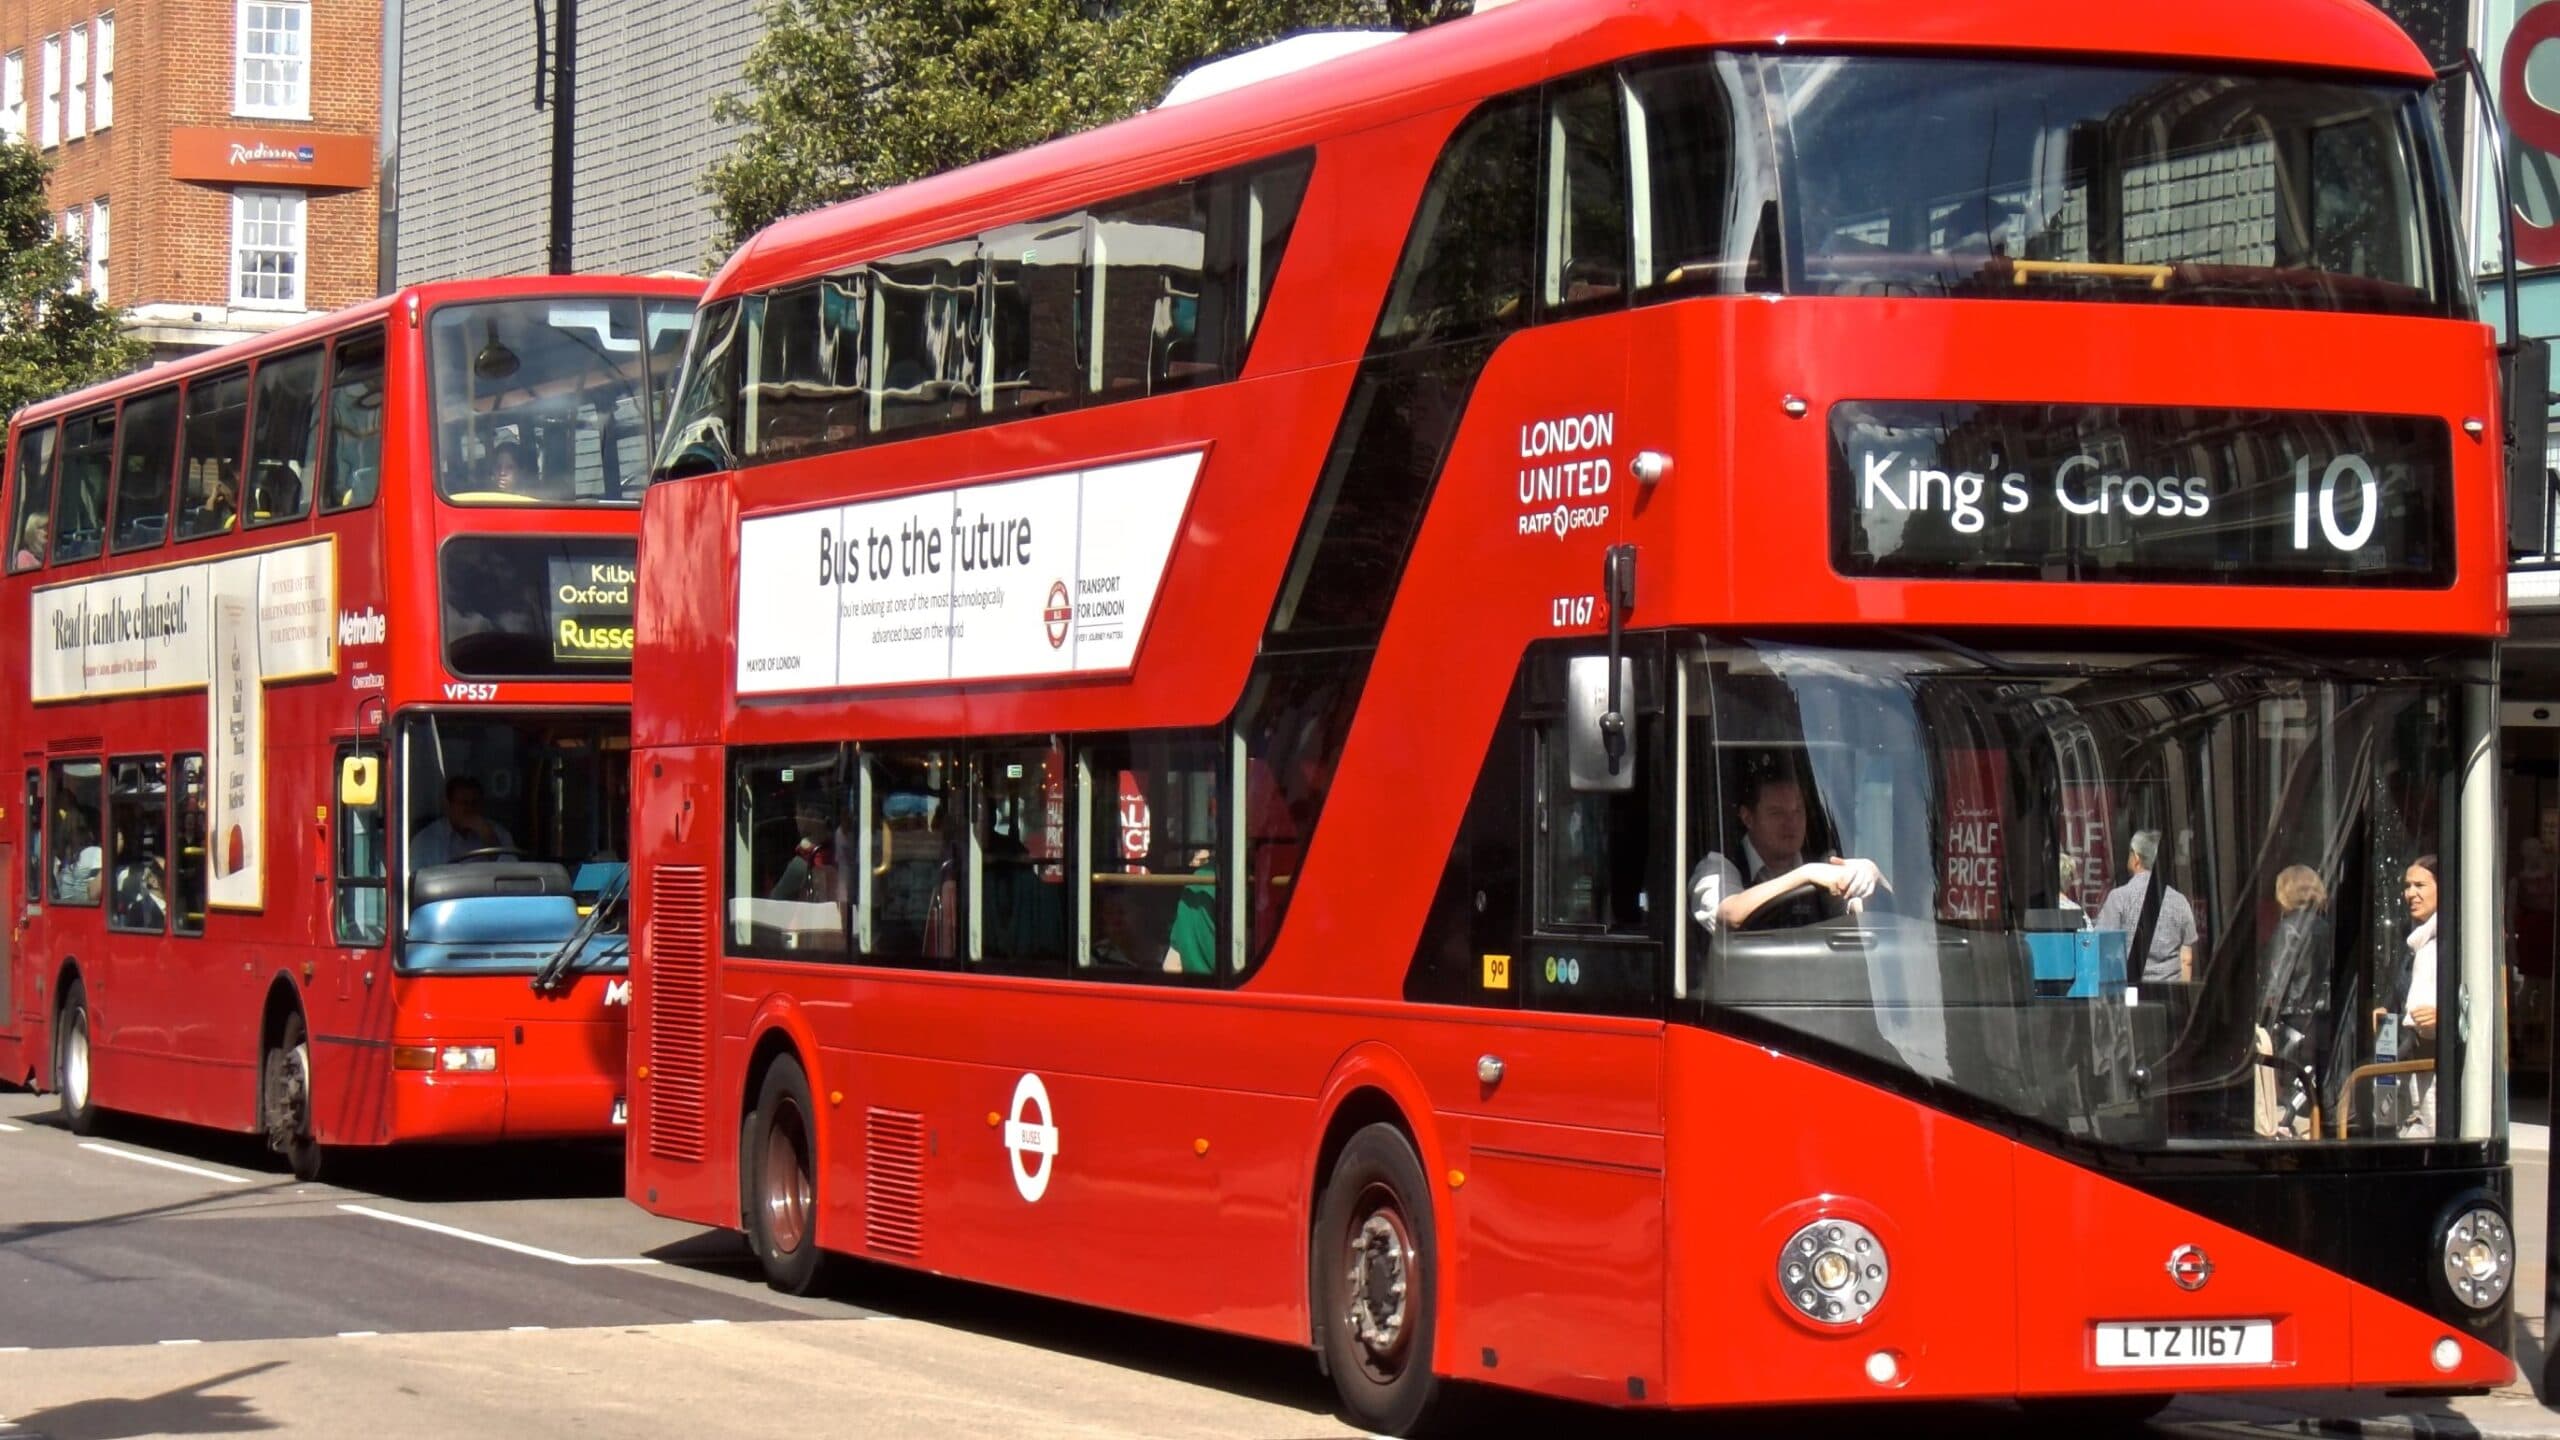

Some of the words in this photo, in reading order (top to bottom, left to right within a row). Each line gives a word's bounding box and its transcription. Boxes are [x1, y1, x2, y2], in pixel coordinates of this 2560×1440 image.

[229, 142, 298, 166] Radisson
[1521, 412, 1614, 458] LONDON
[1519, 459, 1611, 504] UNITED
[1864, 450, 2029, 533] King's
[2055, 455, 2210, 517] Cross
[2294, 454, 2377, 551] 10
[1519, 512, 1552, 535] RATP
[1569, 505, 1609, 530] GROUP
[820, 527, 860, 586] Bus
[868, 527, 893, 581] to
[901, 514, 941, 577] the
[951, 507, 1031, 572] future
[559, 584, 628, 604] Oxford
[1077, 576, 1120, 594] TRANSPORT
[93, 597, 116, 645] and
[118, 596, 132, 642] be
[1077, 603, 1091, 618] FOR
[1092, 600, 1124, 618] LONDON
[1553, 597, 1594, 626] LT167
[338, 606, 385, 646] Metroline
[767, 657, 775, 671] OF
[443, 684, 498, 700] VP557
[1949, 821, 1999, 853] HALF
[1948, 857, 1997, 886] PRICE
[1022, 1129, 1041, 1145] BUSES
[2123, 1326, 2181, 1357] LTZ
[2192, 1325, 2246, 1357] 1167
